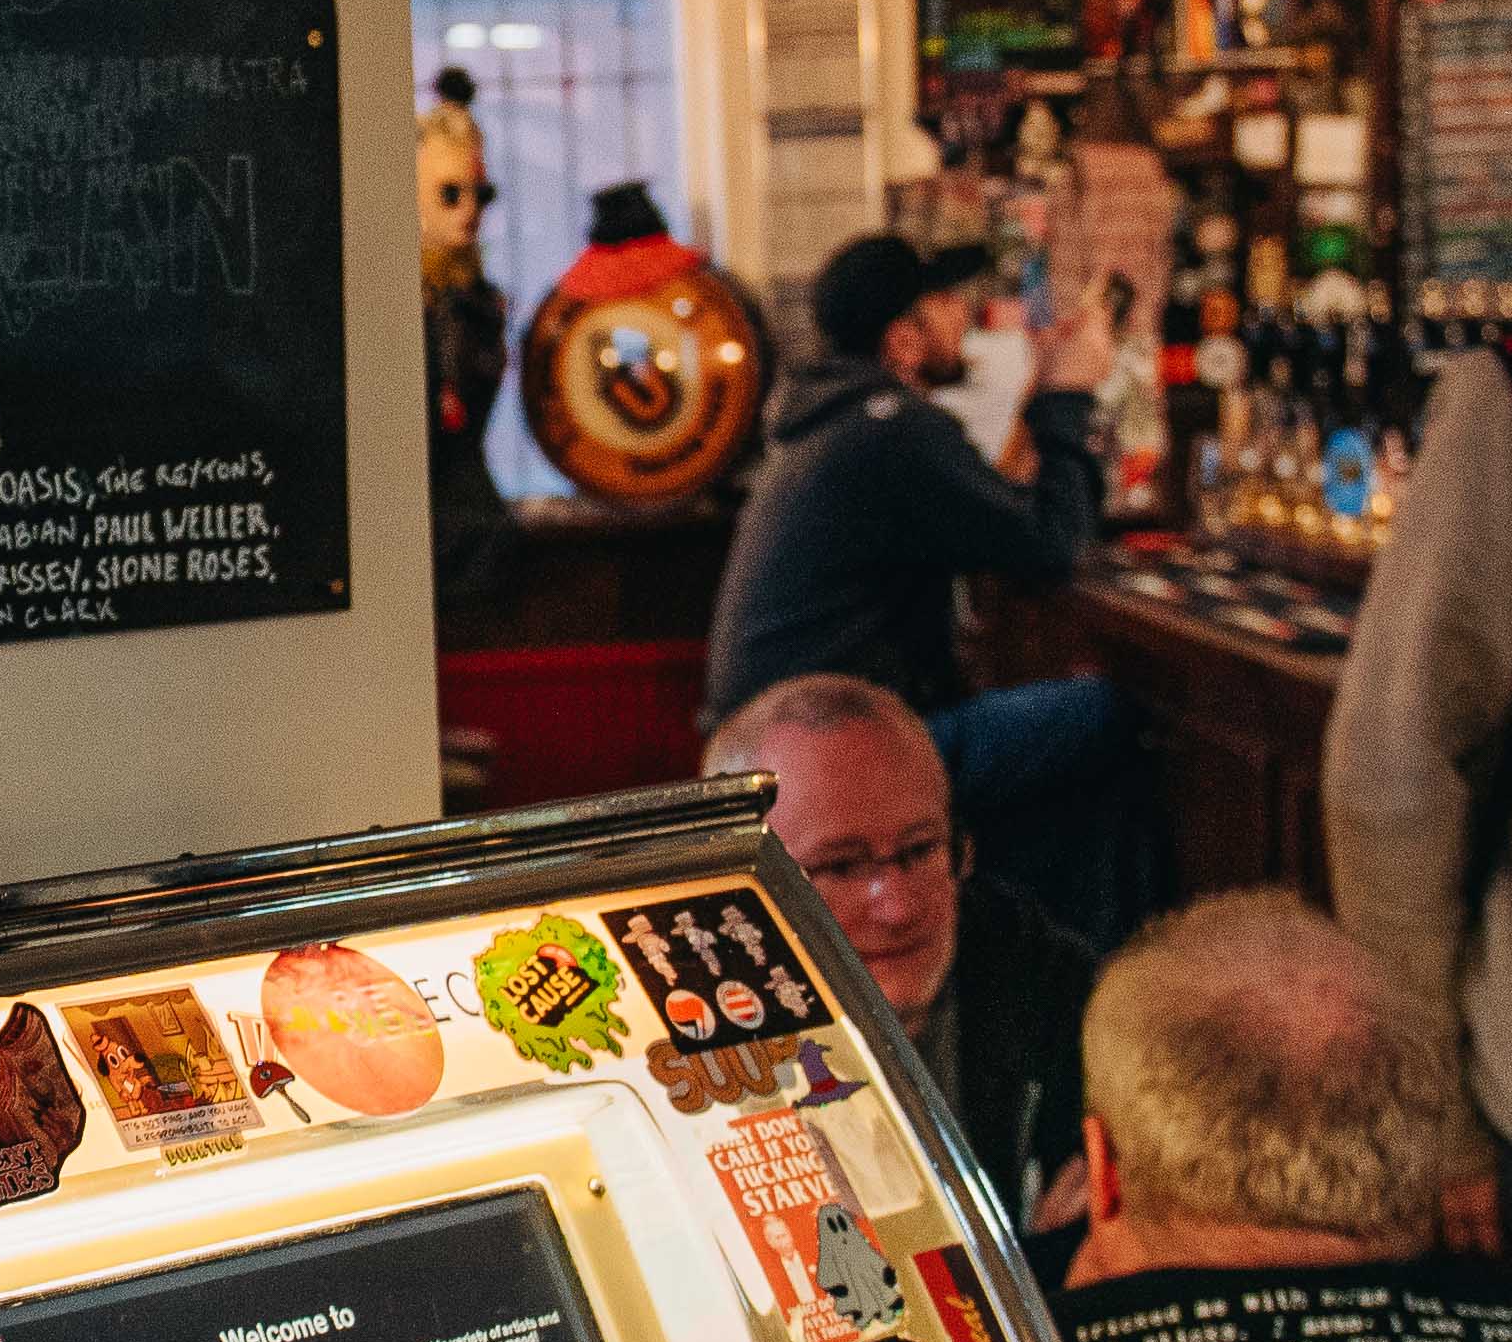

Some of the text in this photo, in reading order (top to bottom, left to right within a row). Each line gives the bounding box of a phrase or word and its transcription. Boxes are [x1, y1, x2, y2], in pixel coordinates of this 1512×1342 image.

[95, 470, 145, 496] THE
[95, 549, 177, 590] STONE
[24, 598, 117, 629] CLARK
[500, 955, 549, 1004] LOST
[518, 966, 581, 1024] CAUSE
[732, 1153, 825, 1190] FUCKING
[1242, 1287, 1309, 1314] with
[329, 1305, 356, 1331] to
[502, 1316, 538, 1337] artists
[538, 1310, 560, 1327] and
